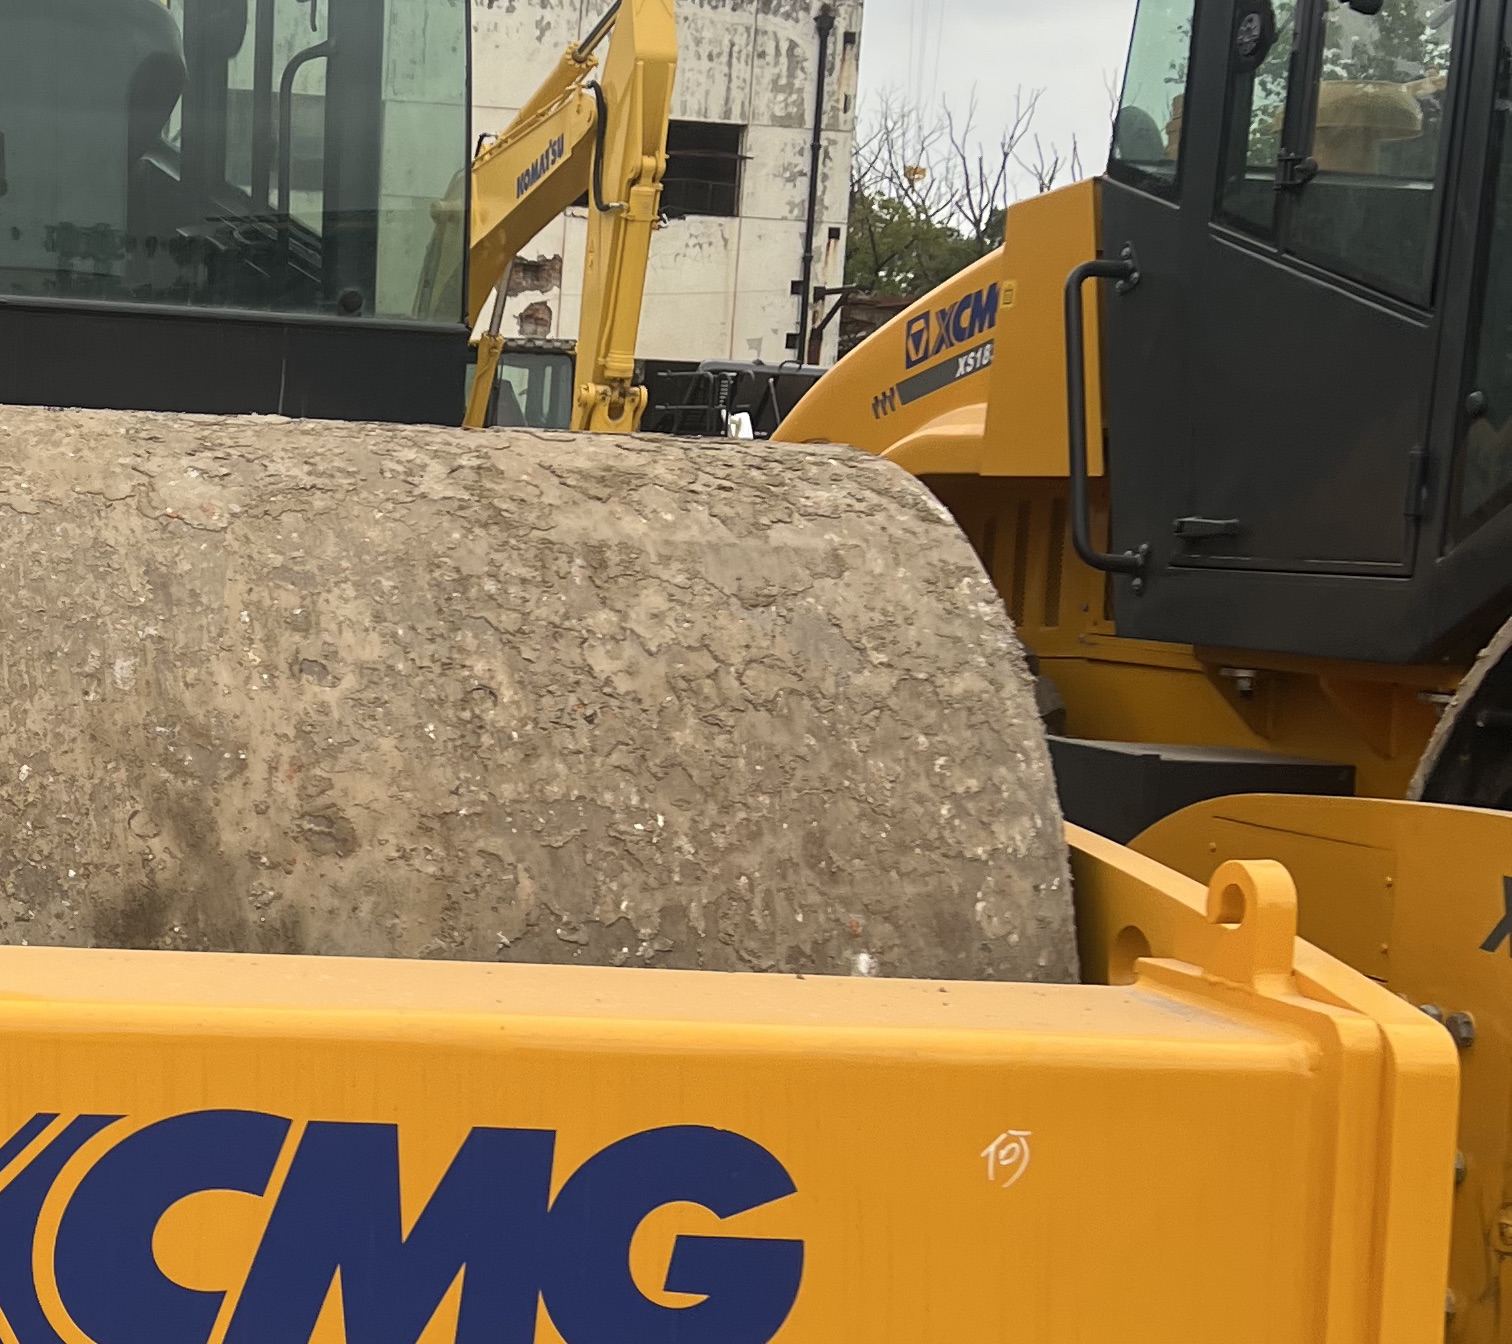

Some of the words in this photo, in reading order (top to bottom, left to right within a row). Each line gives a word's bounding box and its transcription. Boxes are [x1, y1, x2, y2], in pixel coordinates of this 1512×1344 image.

[516, 132, 564, 199] KOMATSU
[929, 282, 999, 356] XCM
[955, 343, 994, 378] XS18
